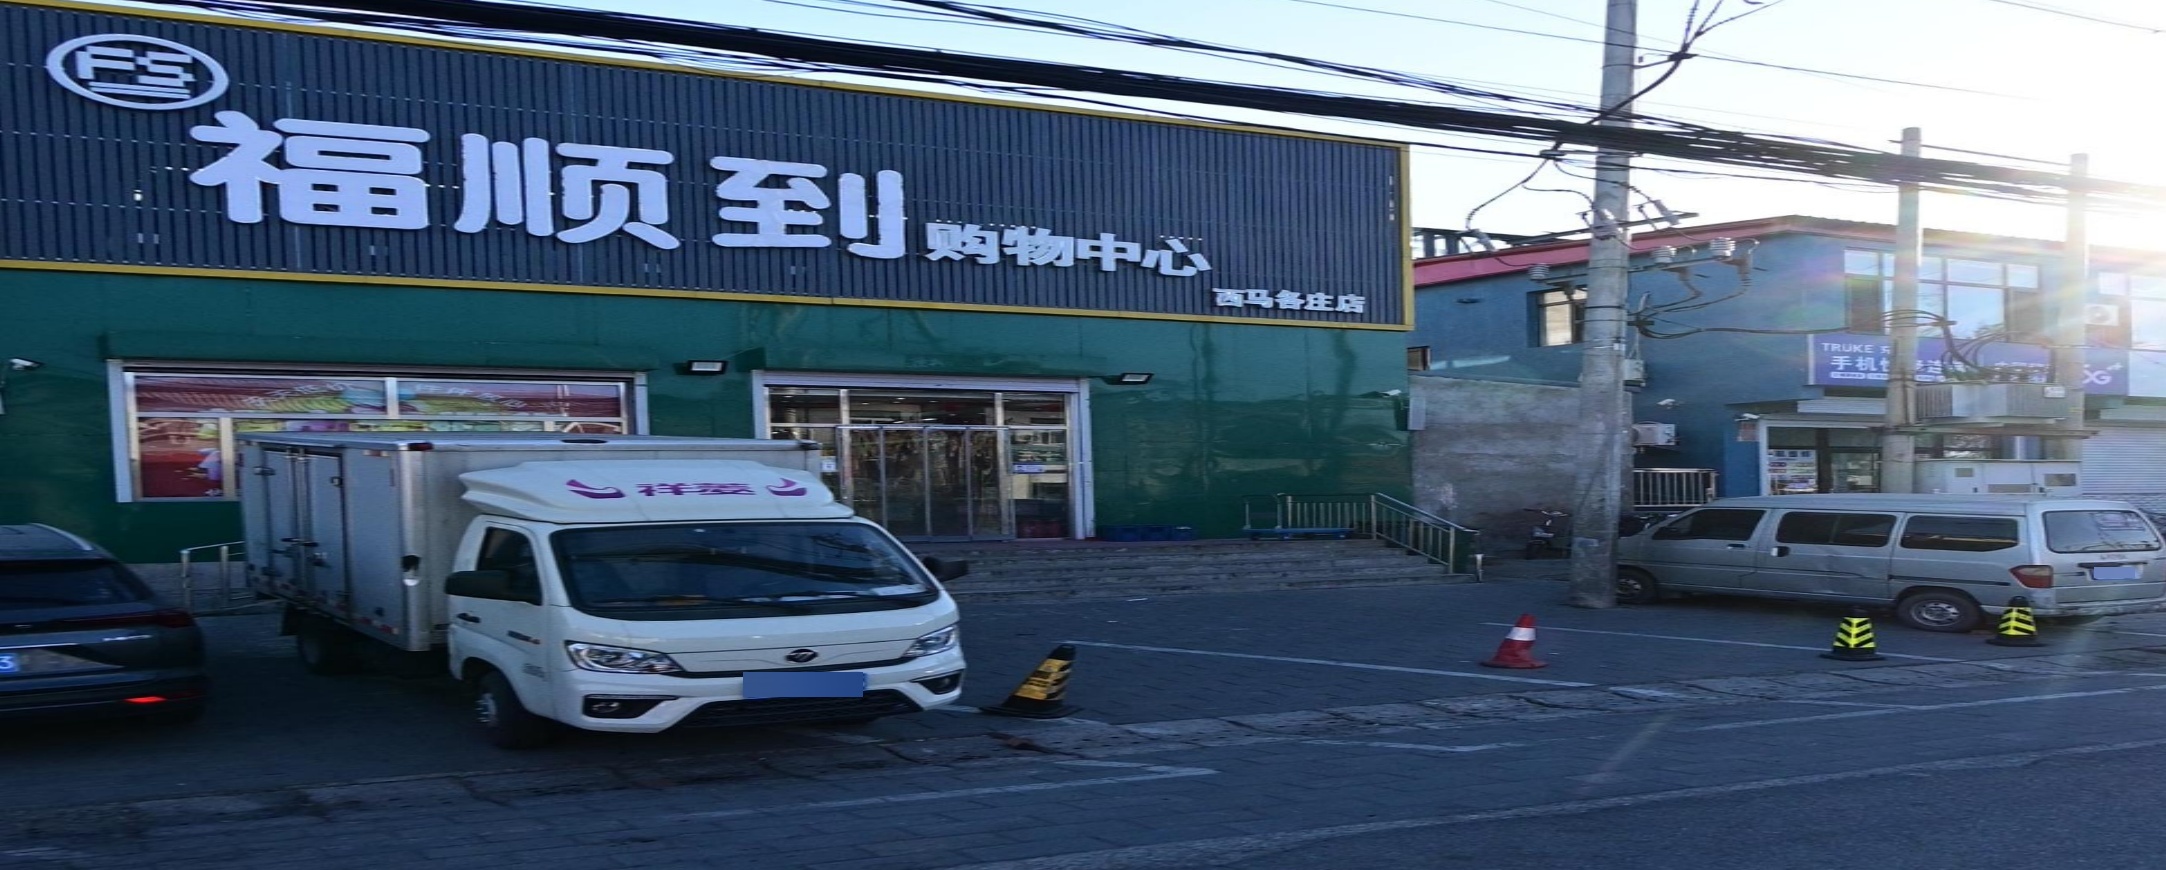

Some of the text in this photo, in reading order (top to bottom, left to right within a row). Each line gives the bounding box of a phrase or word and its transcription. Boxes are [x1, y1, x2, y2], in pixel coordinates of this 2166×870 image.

[190, 110, 904, 259] 福顺到
[925, 222, 1212, 276] 购物中心
[1212, 287, 1366, 313] 西马各庄店
